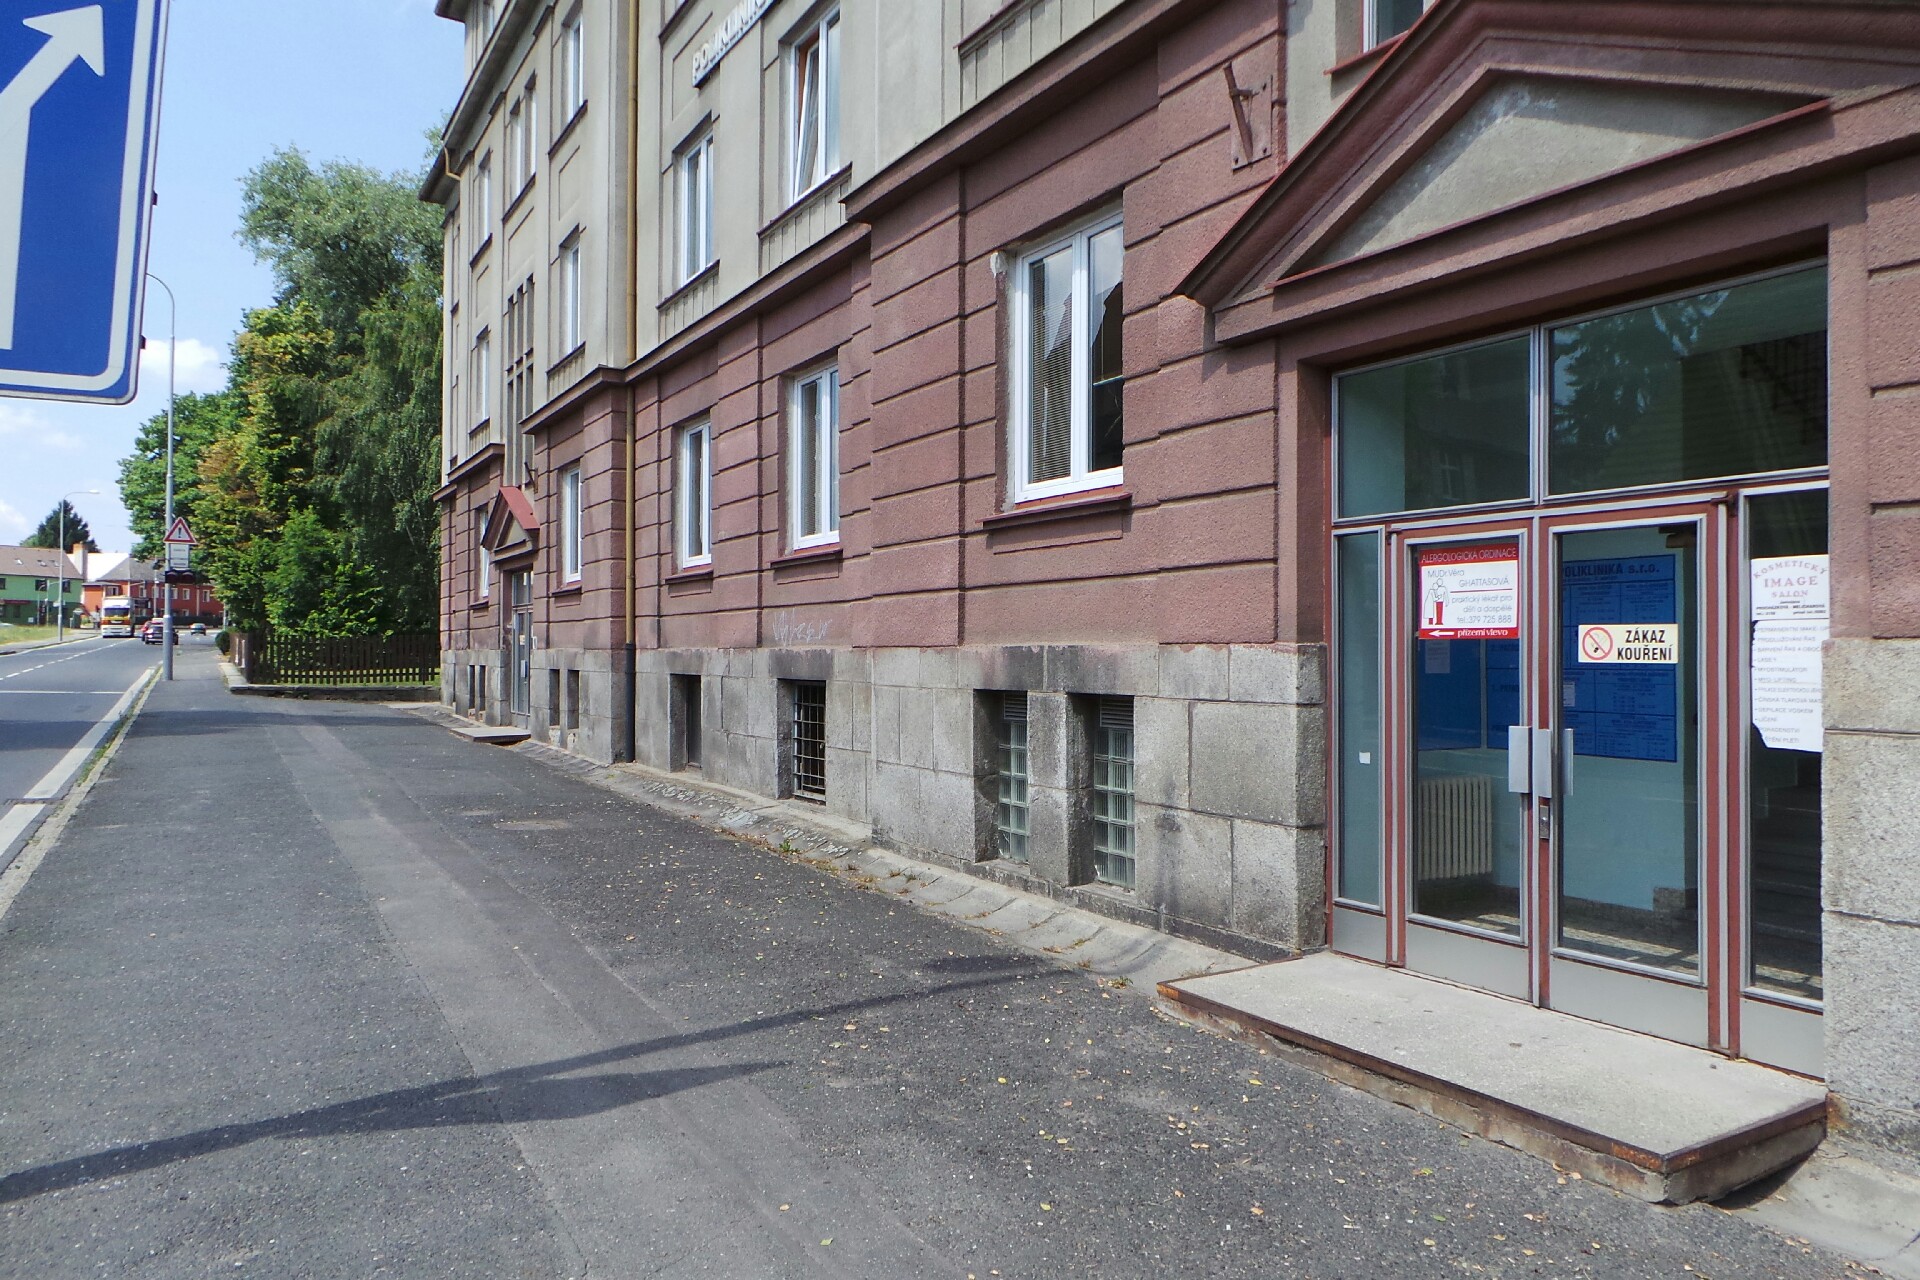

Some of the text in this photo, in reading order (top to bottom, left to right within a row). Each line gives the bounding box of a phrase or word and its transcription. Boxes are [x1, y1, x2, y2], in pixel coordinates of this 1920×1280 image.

[1479, 548, 1516, 559] ORDINACE
[1562, 563, 1660, 578] OLIKLINIKA s.r.o.
[1764, 576, 1818, 588] IMAGE
[1772, 589, 1808, 598] SALON
[1485, 628, 1509, 636] vlevo
[1625, 627, 1665, 643] ZÁKAZ
[1617, 644, 1673, 660] KOUŘENÍ
